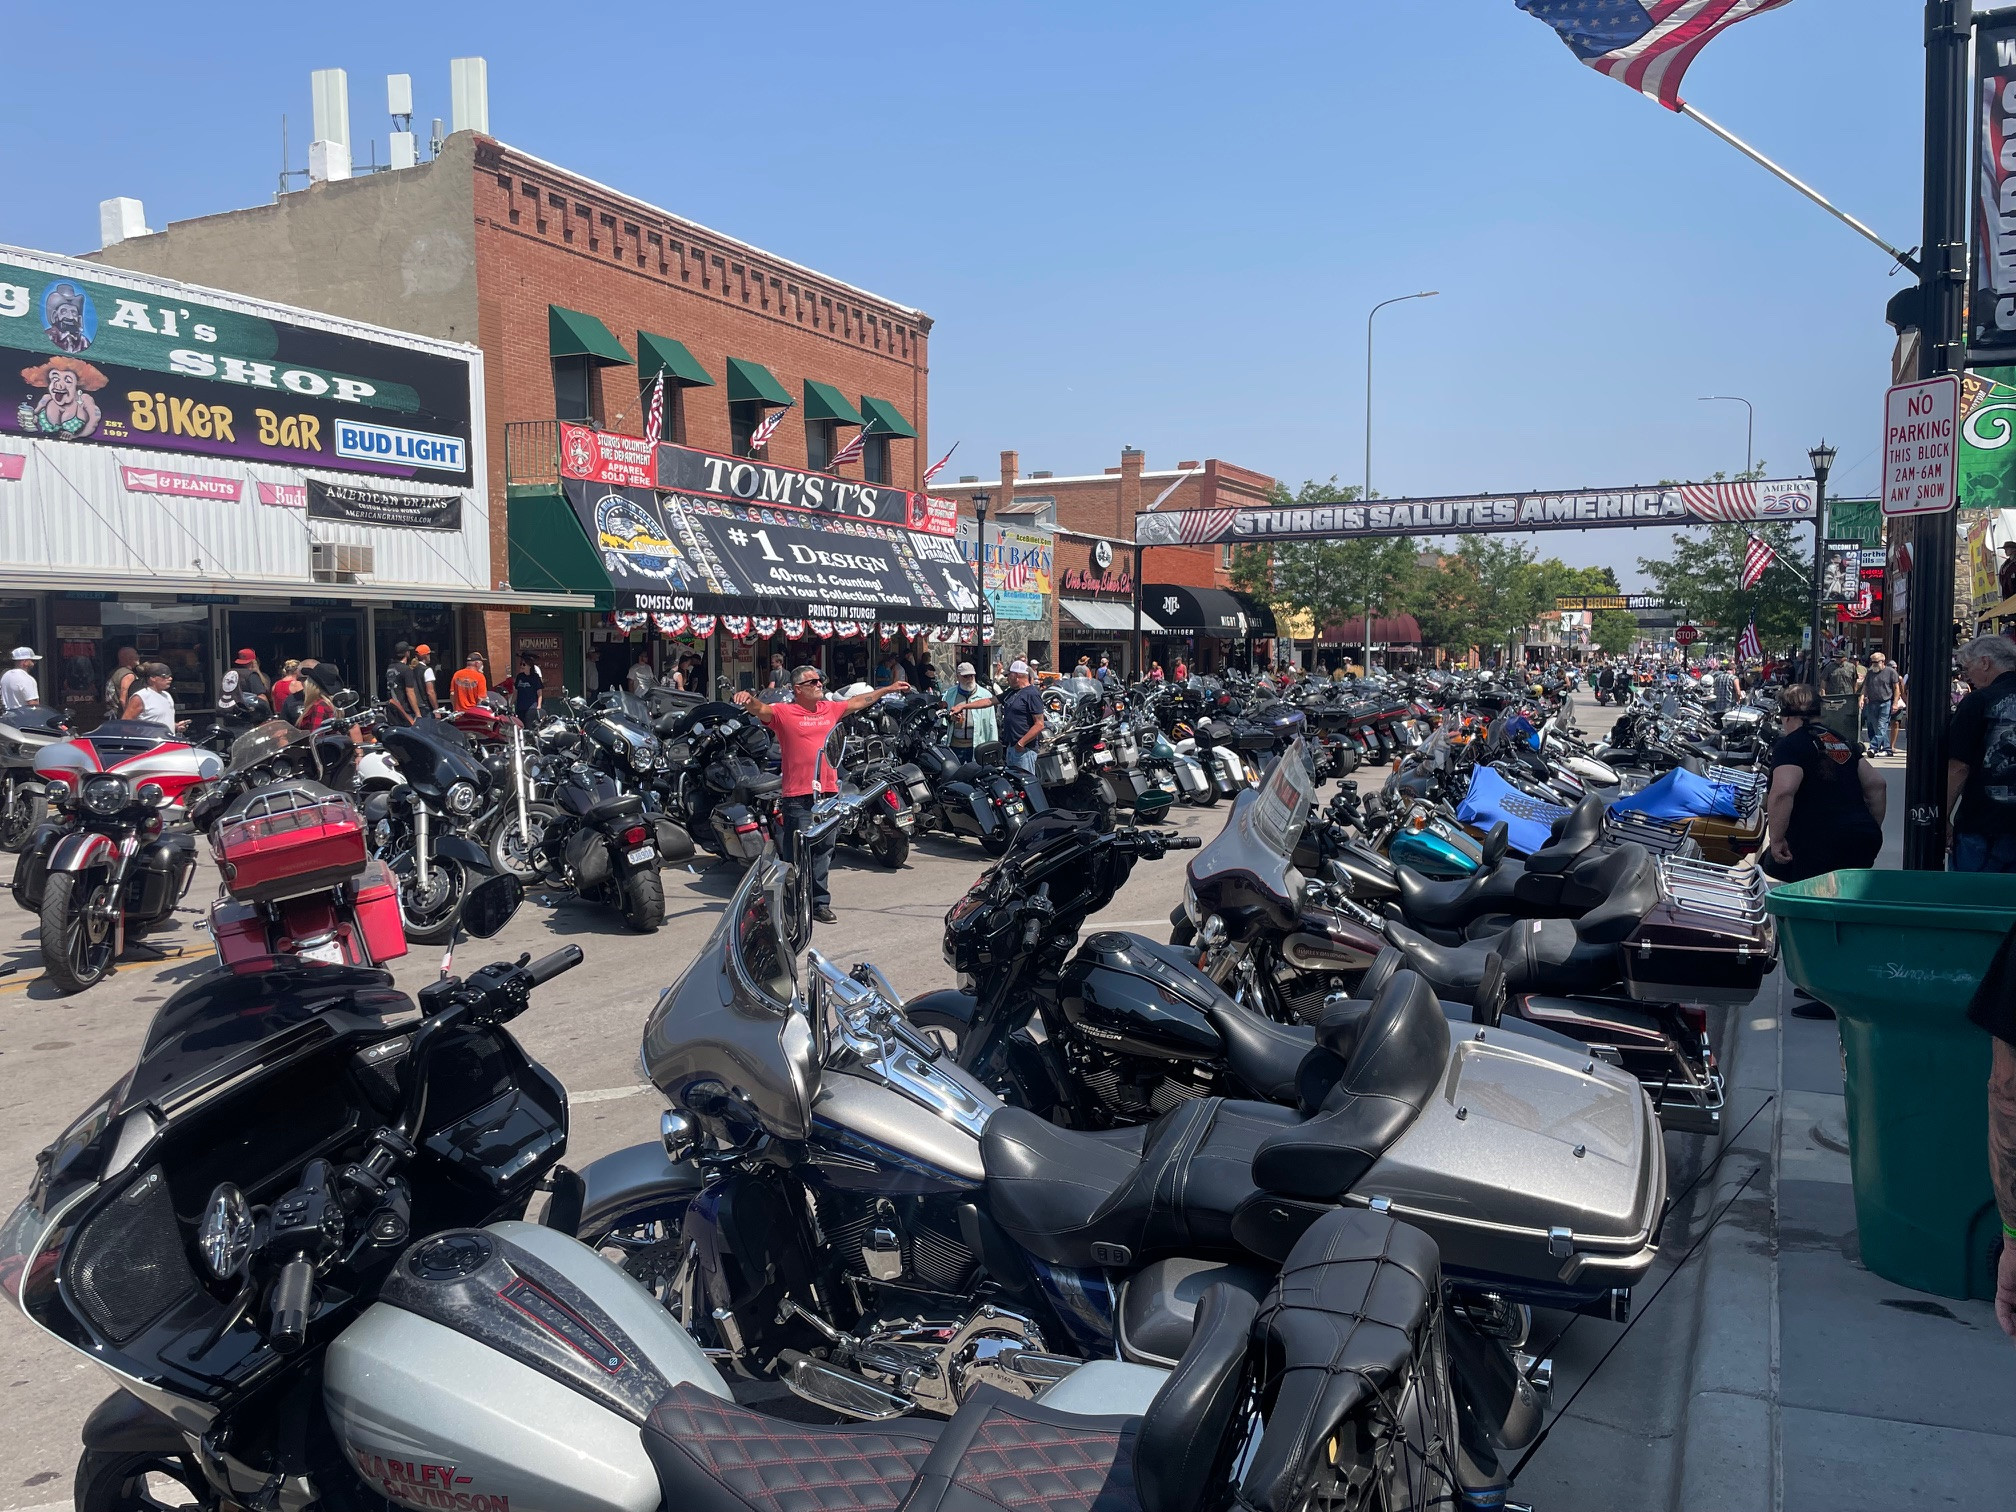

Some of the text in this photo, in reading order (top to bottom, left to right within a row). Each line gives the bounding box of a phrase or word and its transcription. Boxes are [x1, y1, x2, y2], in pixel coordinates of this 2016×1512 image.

[109, 299, 218, 343] Al's
[170, 349, 377, 404] SHOP
[1908, 394, 1933, 417] NO
[105, 420, 126, 429] EST.
[1890, 419, 1951, 445] PARKING
[342, 428, 459, 464] BUD LIGHT
[597, 434, 653, 455] STURGIS VOLUNTEER
[1890, 442, 1949, 464] THIS BLOCK
[600, 447, 651, 466] FIRE DEPARTMENT
[601, 471, 651, 486] SOLD HERE
[608, 463, 645, 477] APPAREL
[1895, 463, 1942, 482] 2AM-6AM
[159, 477, 171, 488] &
[173, 478, 234, 495] PEANUTS
[704, 457, 824, 509] TOM'S
[831, 482, 878, 518] T'S
[1763, 482, 1811, 493] AMERICA
[1891, 483, 1945, 502] ANY SNOW
[326, 486, 448, 509] AMERICAN GRAINS
[1762, 493, 1812, 515] 250
[1234, 491, 1688, 534] STURGIS SALUTES AMERICA
[1829, 520, 1880, 544] TATTOO
[728, 527, 784, 561] #1
[908, 532, 966, 564] DULUTH
[957, 539, 1006, 565] LLET
[788, 544, 889, 574] DESIGN
[818, 573, 828, 585] &
[829, 575, 883, 591] Counting!
[1845, 551, 1857, 599] STURGIS
[635, 594, 694, 611] TOMSTS.COM
[752, 582, 911, 606] Start Your Collection Today
[1556, 597, 1583, 610] RUSS
[1586, 597, 1627, 609] BROWN
[840, 606, 847, 618] IN
[849, 607, 876, 620] STURGIS
[948, 612, 960, 623] RIDE
[961, 613, 975, 624] BUCK
[1676, 631, 1697, 640] STOP
[354, 1448, 473, 1491] HARLEY-
